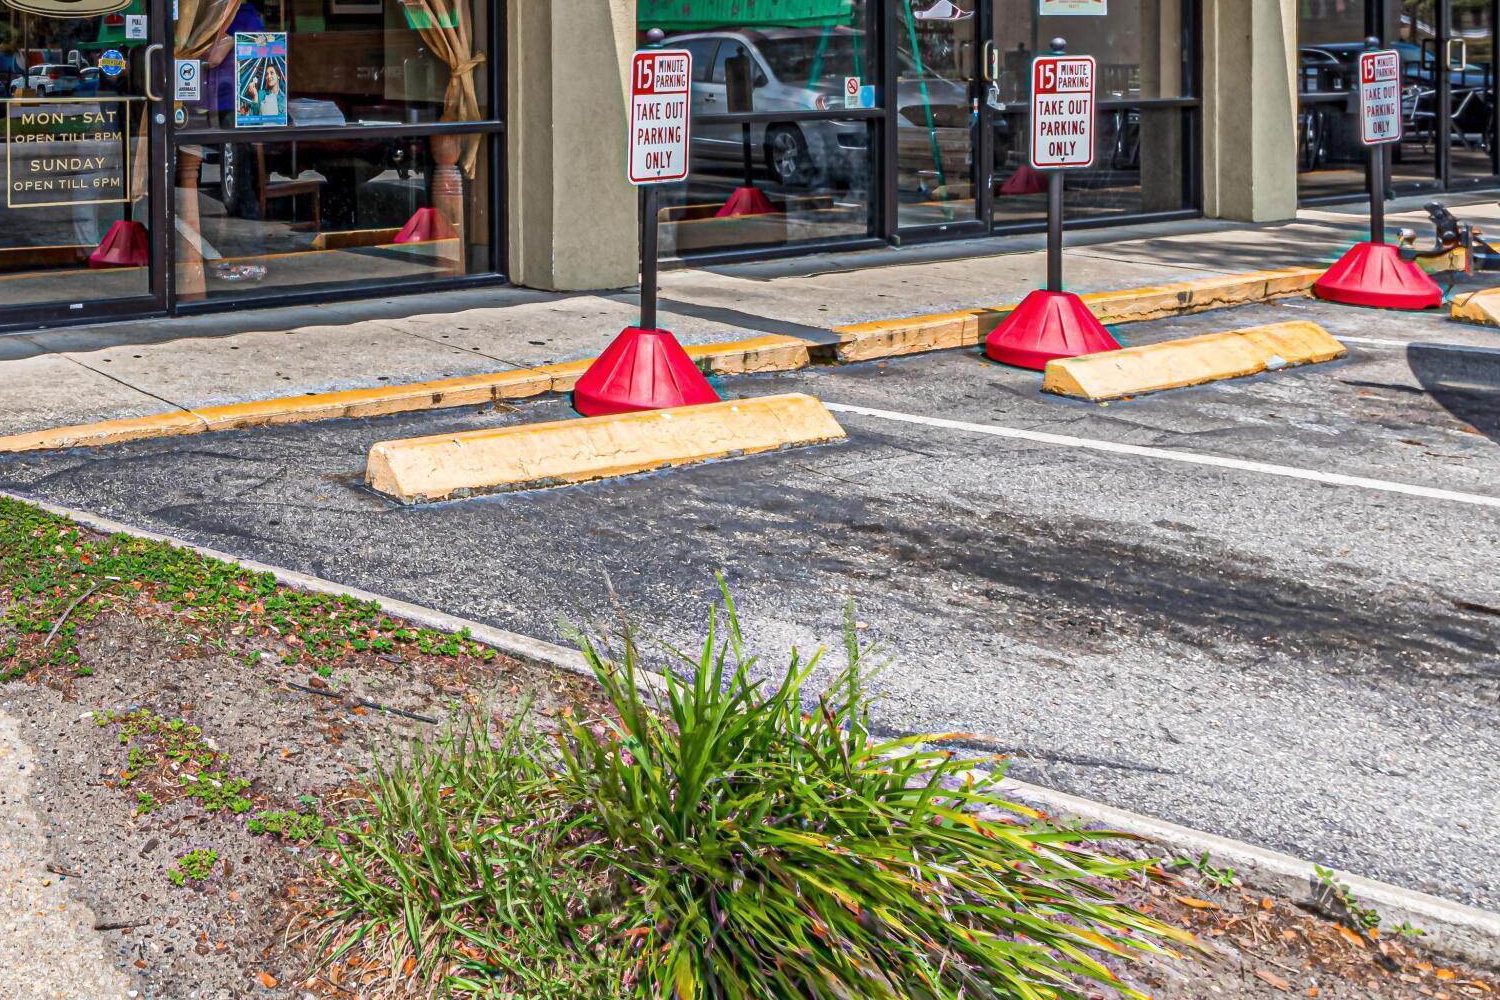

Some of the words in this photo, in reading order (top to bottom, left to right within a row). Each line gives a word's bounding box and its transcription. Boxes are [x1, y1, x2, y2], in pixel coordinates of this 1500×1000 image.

[637, 59, 653, 89] 15
[658, 59, 684, 73] MINUTE
[1363, 58, 1374, 80] 15
[1378, 57, 1393, 66] MINUTE
[1377, 67, 1395, 76] PARKING
[656, 74, 686, 87] PARKING
[1038, 64, 1055, 89] 15
[1061, 64, 1087, 75] MINUTE
[1058, 77, 1089, 88] PARKING
[1365, 87, 1380, 101] TAKE
[1383, 86, 1395, 98] OUT
[636, 103, 661, 120] TAKE
[665, 102, 684, 119] OUT
[1039, 100, 1064, 115] TAKE
[1068, 100, 1088, 115] OUT
[1367, 103, 1394, 117] PARKING
[21, 113, 64, 125] MON
[83, 111, 116, 123] SAT
[1040, 121, 1085, 136] PARKING
[1373, 121, 1390, 133] ONLY
[15, 134, 55, 144] OPEN
[60, 133, 87, 142] TILL
[94, 132, 122, 141] 8PM
[638, 126, 681, 145] PARKING
[1049, 141, 1076, 156] ONLY
[30, 157, 105, 172] SUNDAY
[645, 151, 672, 170] ONLY
[14, 180, 53, 191] OPEN
[58, 179, 88, 189] TILL
[93, 177, 120, 187] 6PM
